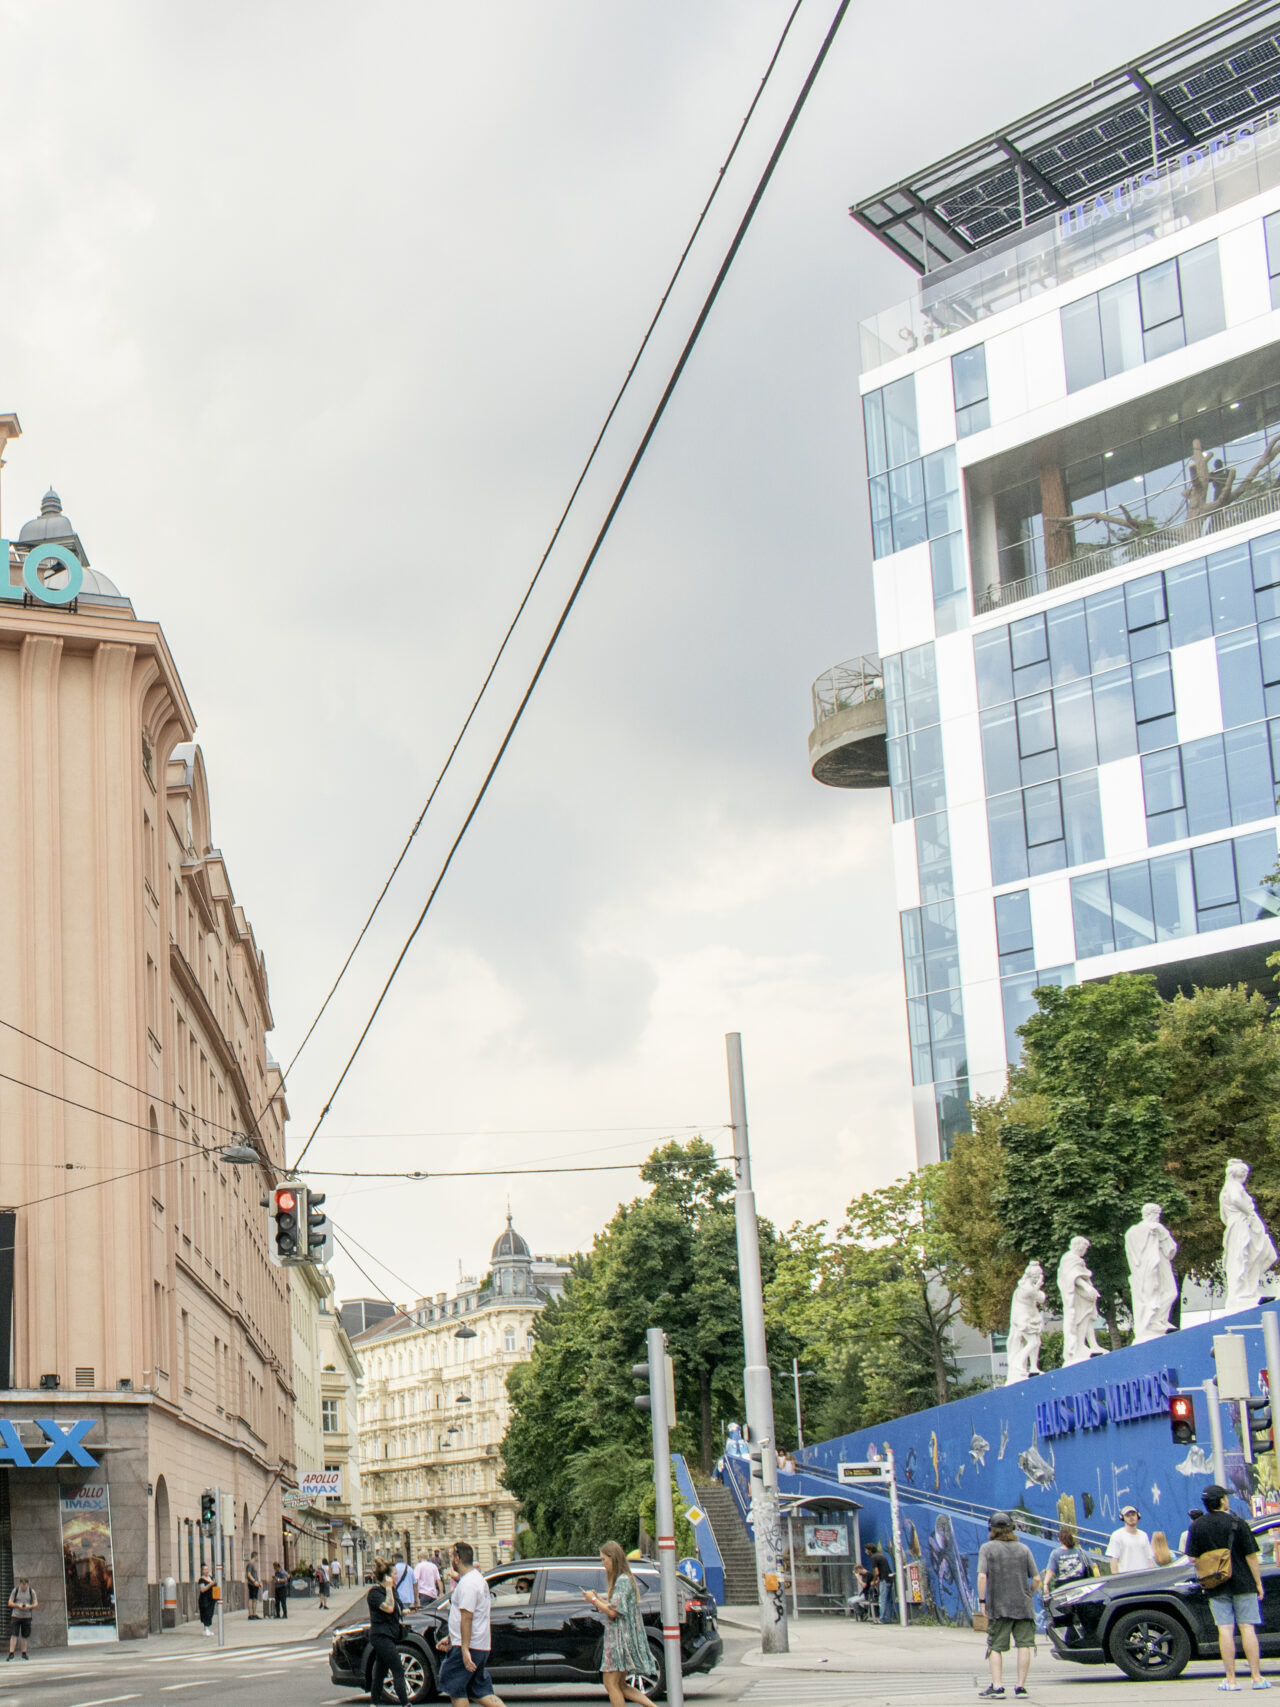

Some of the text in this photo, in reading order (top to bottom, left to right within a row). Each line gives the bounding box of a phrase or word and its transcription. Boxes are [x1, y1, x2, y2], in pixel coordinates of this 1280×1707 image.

[1061, 169, 1161, 239] HAUS
[1179, 123, 1257, 183] DES
[1035, 1368, 1178, 1437] HAUS DES MEERES
[303, 1473, 338, 1483] APOLLO
[302, 1485, 338, 1493] IMAX
[65, 1501, 104, 1510] IMAX
